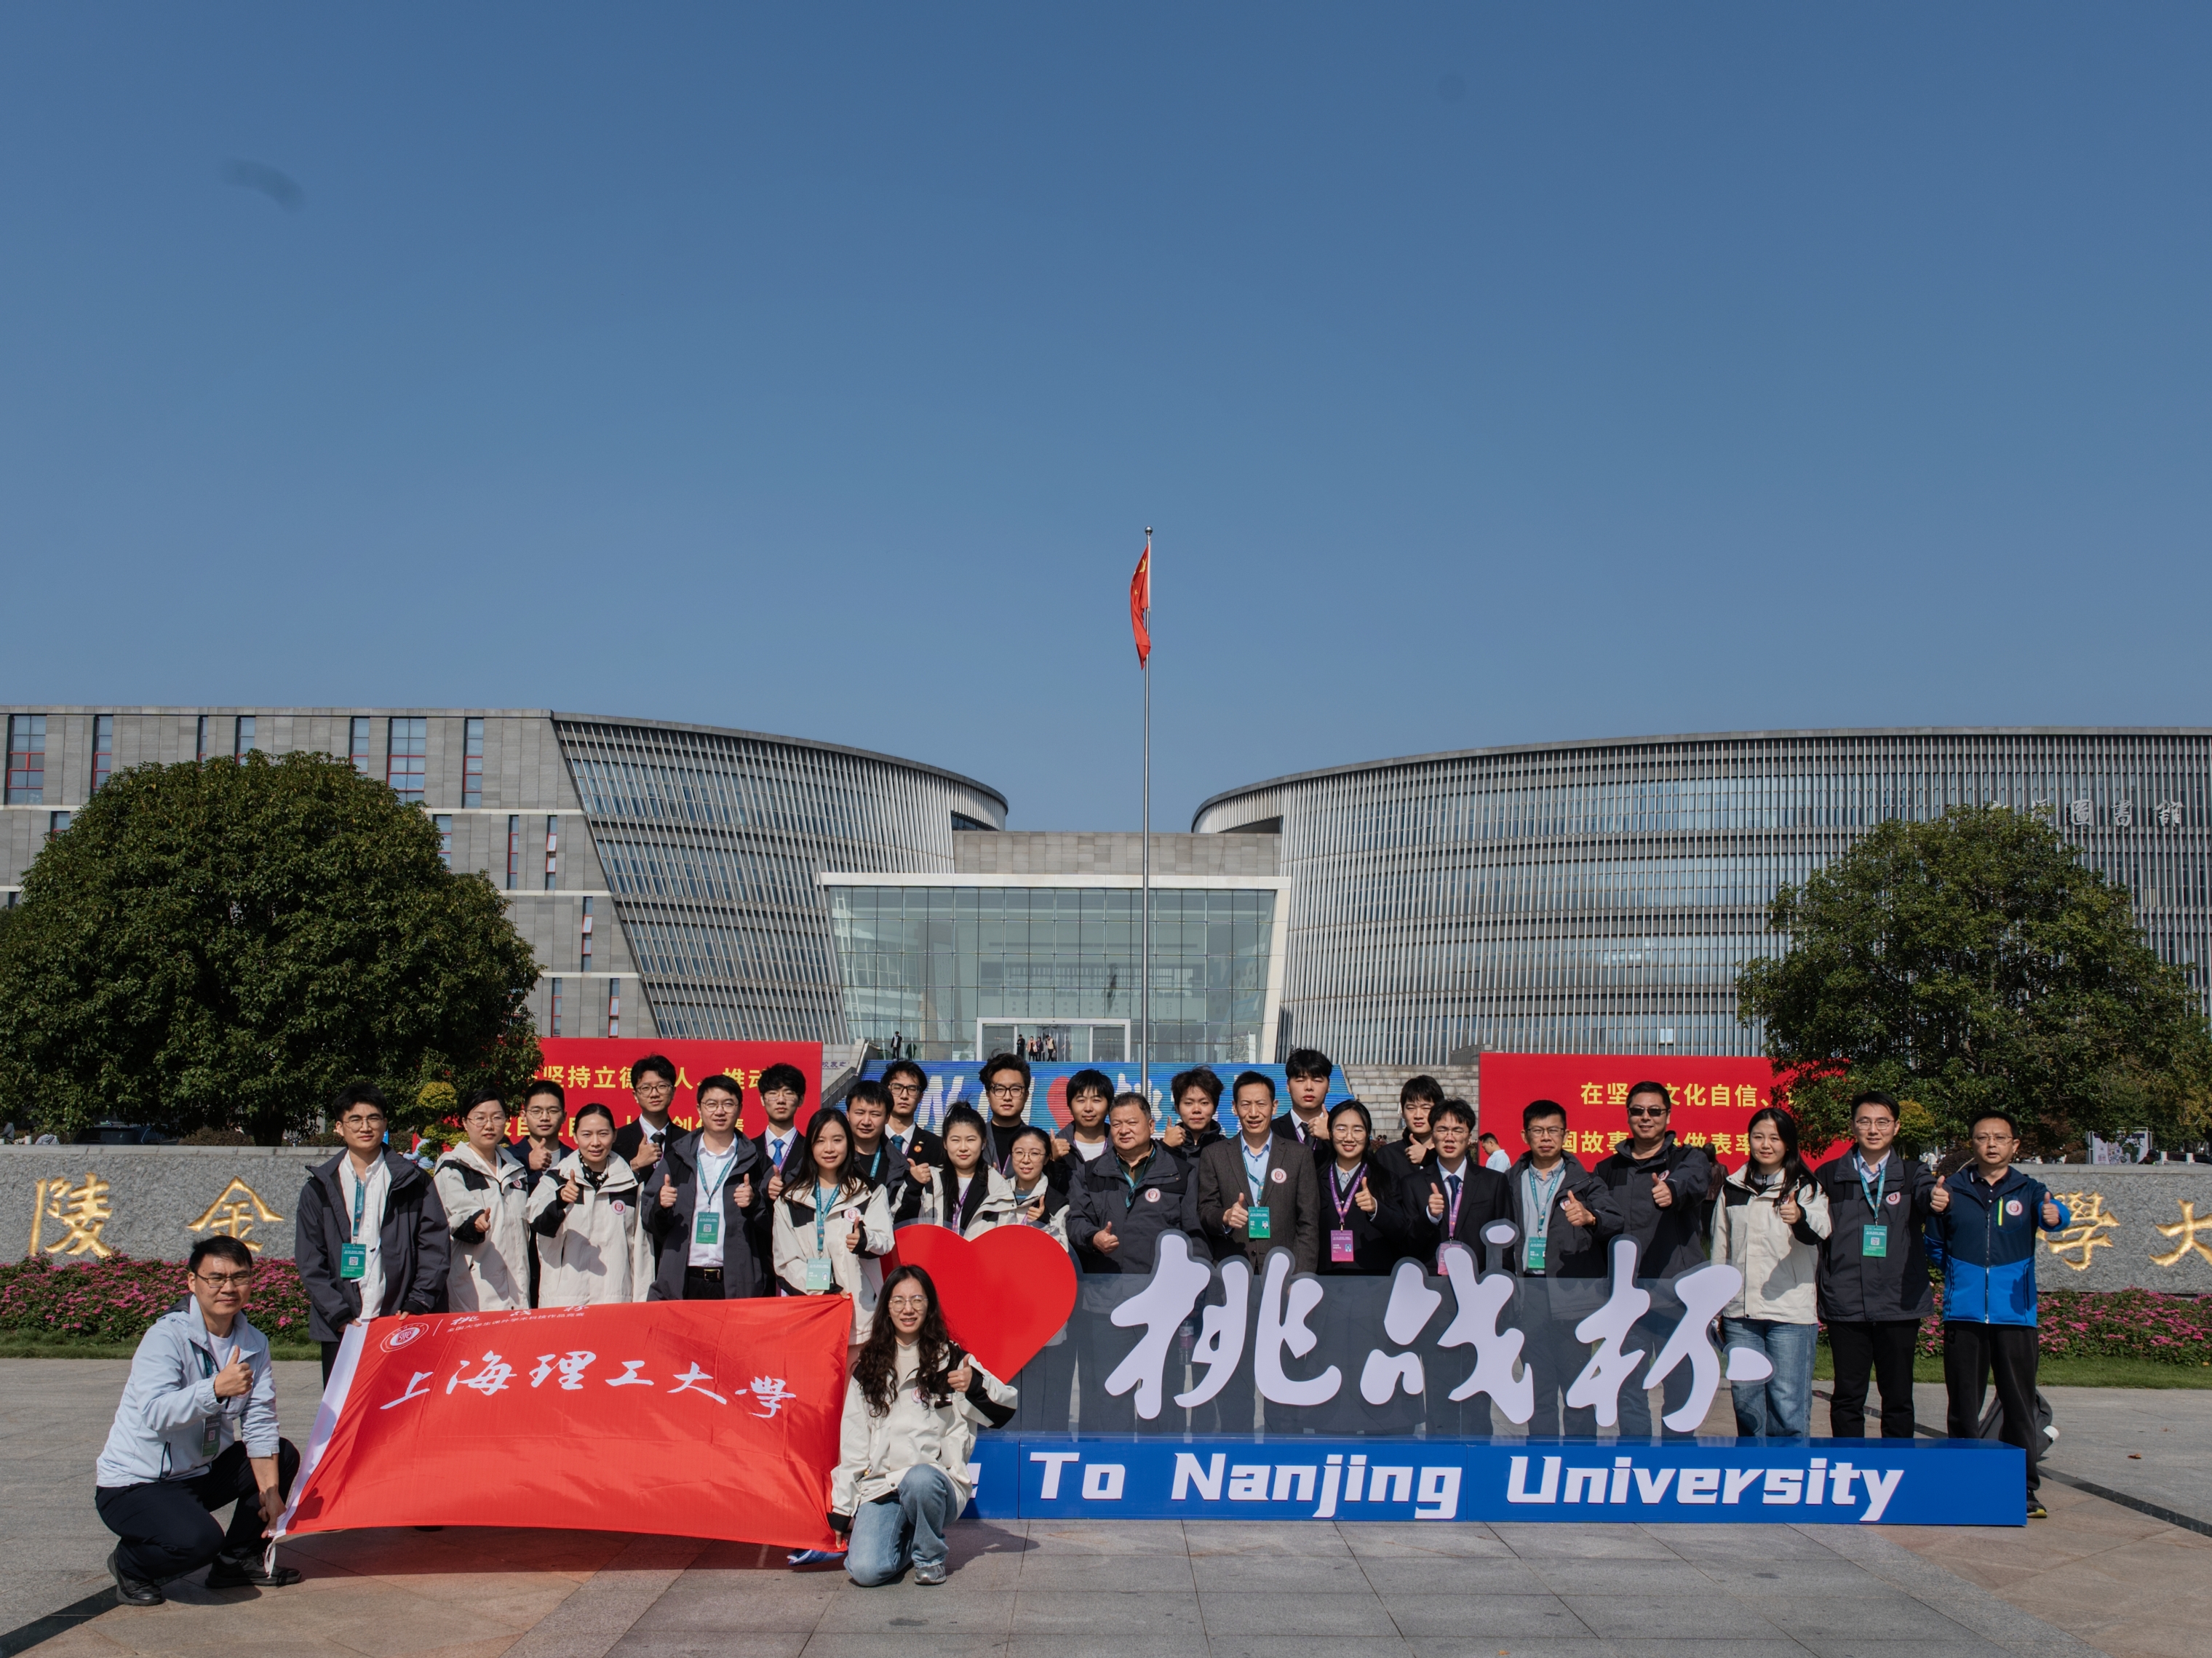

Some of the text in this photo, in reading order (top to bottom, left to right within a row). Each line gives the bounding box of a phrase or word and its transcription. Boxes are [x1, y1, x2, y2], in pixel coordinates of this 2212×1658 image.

[1986, 799, 2184, 827] 圖書館
[1580, 1082, 1796, 1107] 在坚文化自信、
[1030, 1452, 1126, 1500] To
[1171, 1453, 1463, 1519] Nanjing
[1506, 1456, 1904, 1522] University
